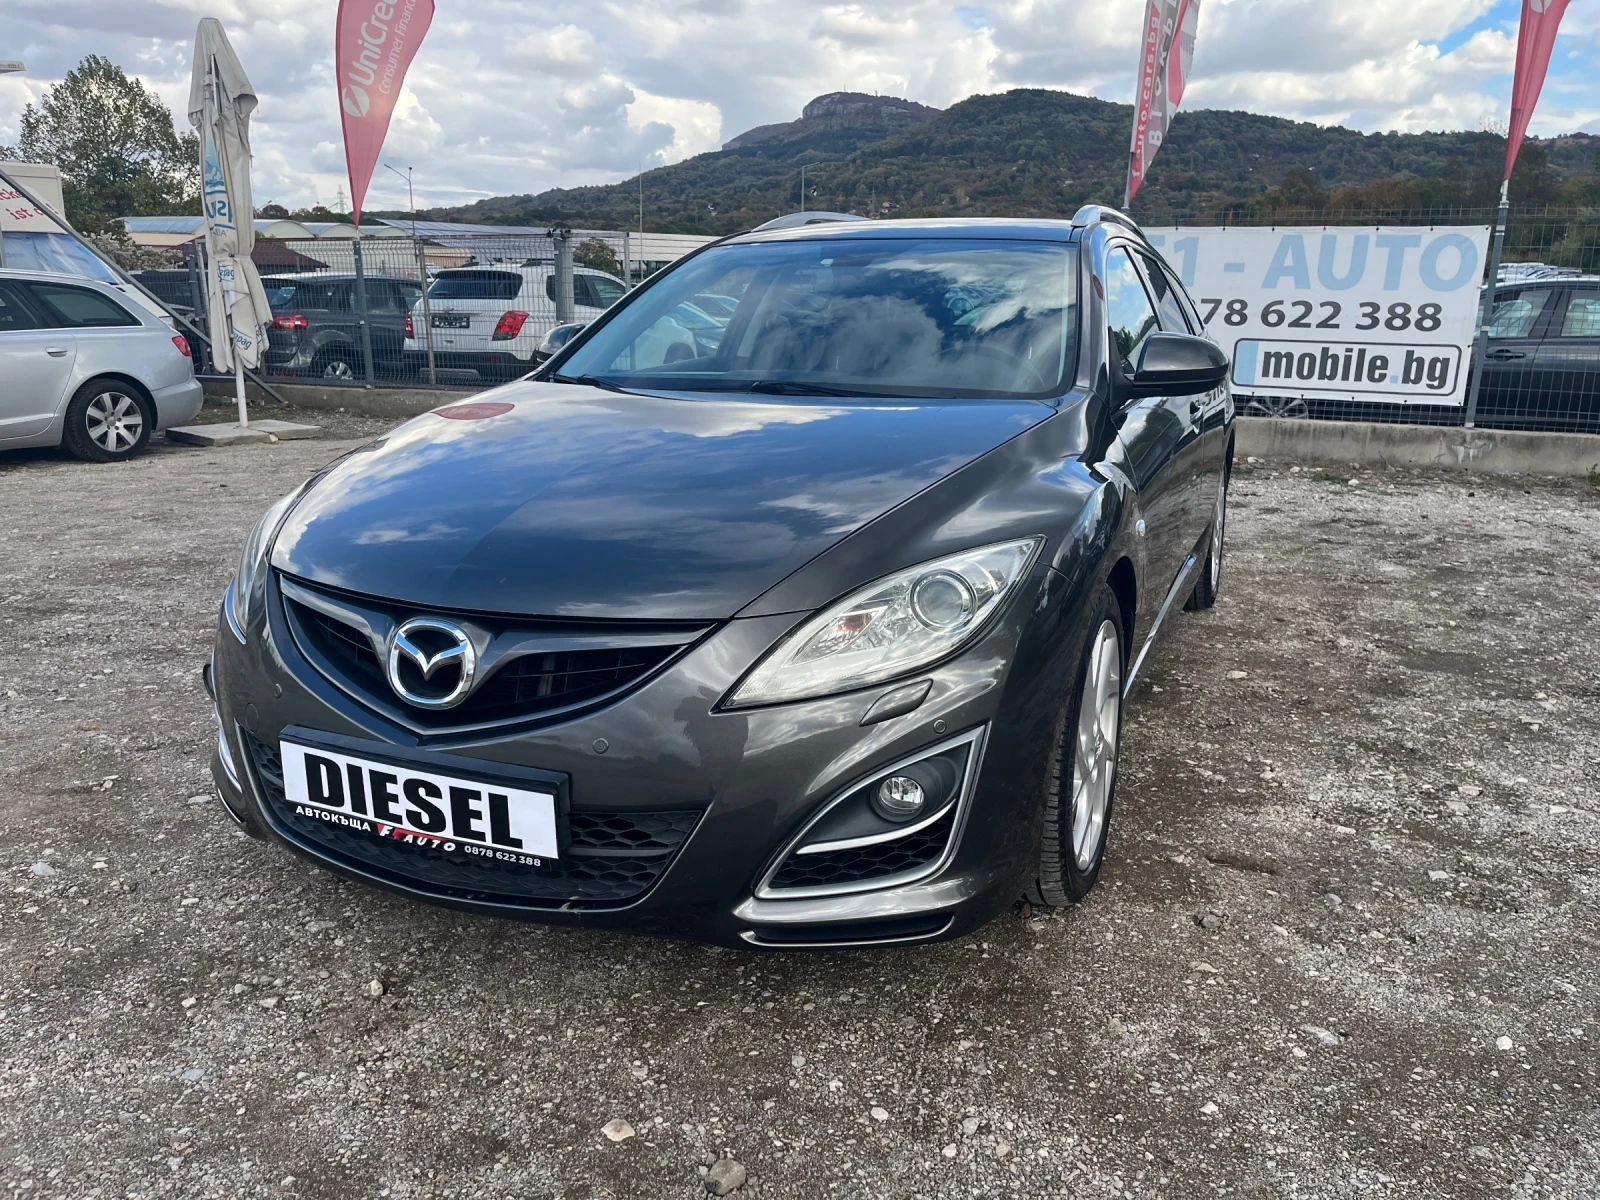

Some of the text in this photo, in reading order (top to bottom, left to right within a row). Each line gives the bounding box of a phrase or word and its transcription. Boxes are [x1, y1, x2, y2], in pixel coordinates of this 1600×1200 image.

[379, 36, 404, 94] Consumer
[5, 208, 33, 220] ist
[1260, 233, 1479, 292] AUTO
[1192, 298, 1442, 332] 78 622 388
[1261, 346, 1451, 390] mobile.bg
[303, 752, 523, 850] DIESEL
[295, 805, 371, 832] АВТОКЪЩА
[403, 834, 456, 852] AUTO
[464, 845, 493, 858] 0878
[495, 851, 517, 863] 622
[518, 856, 541, 867] 388
